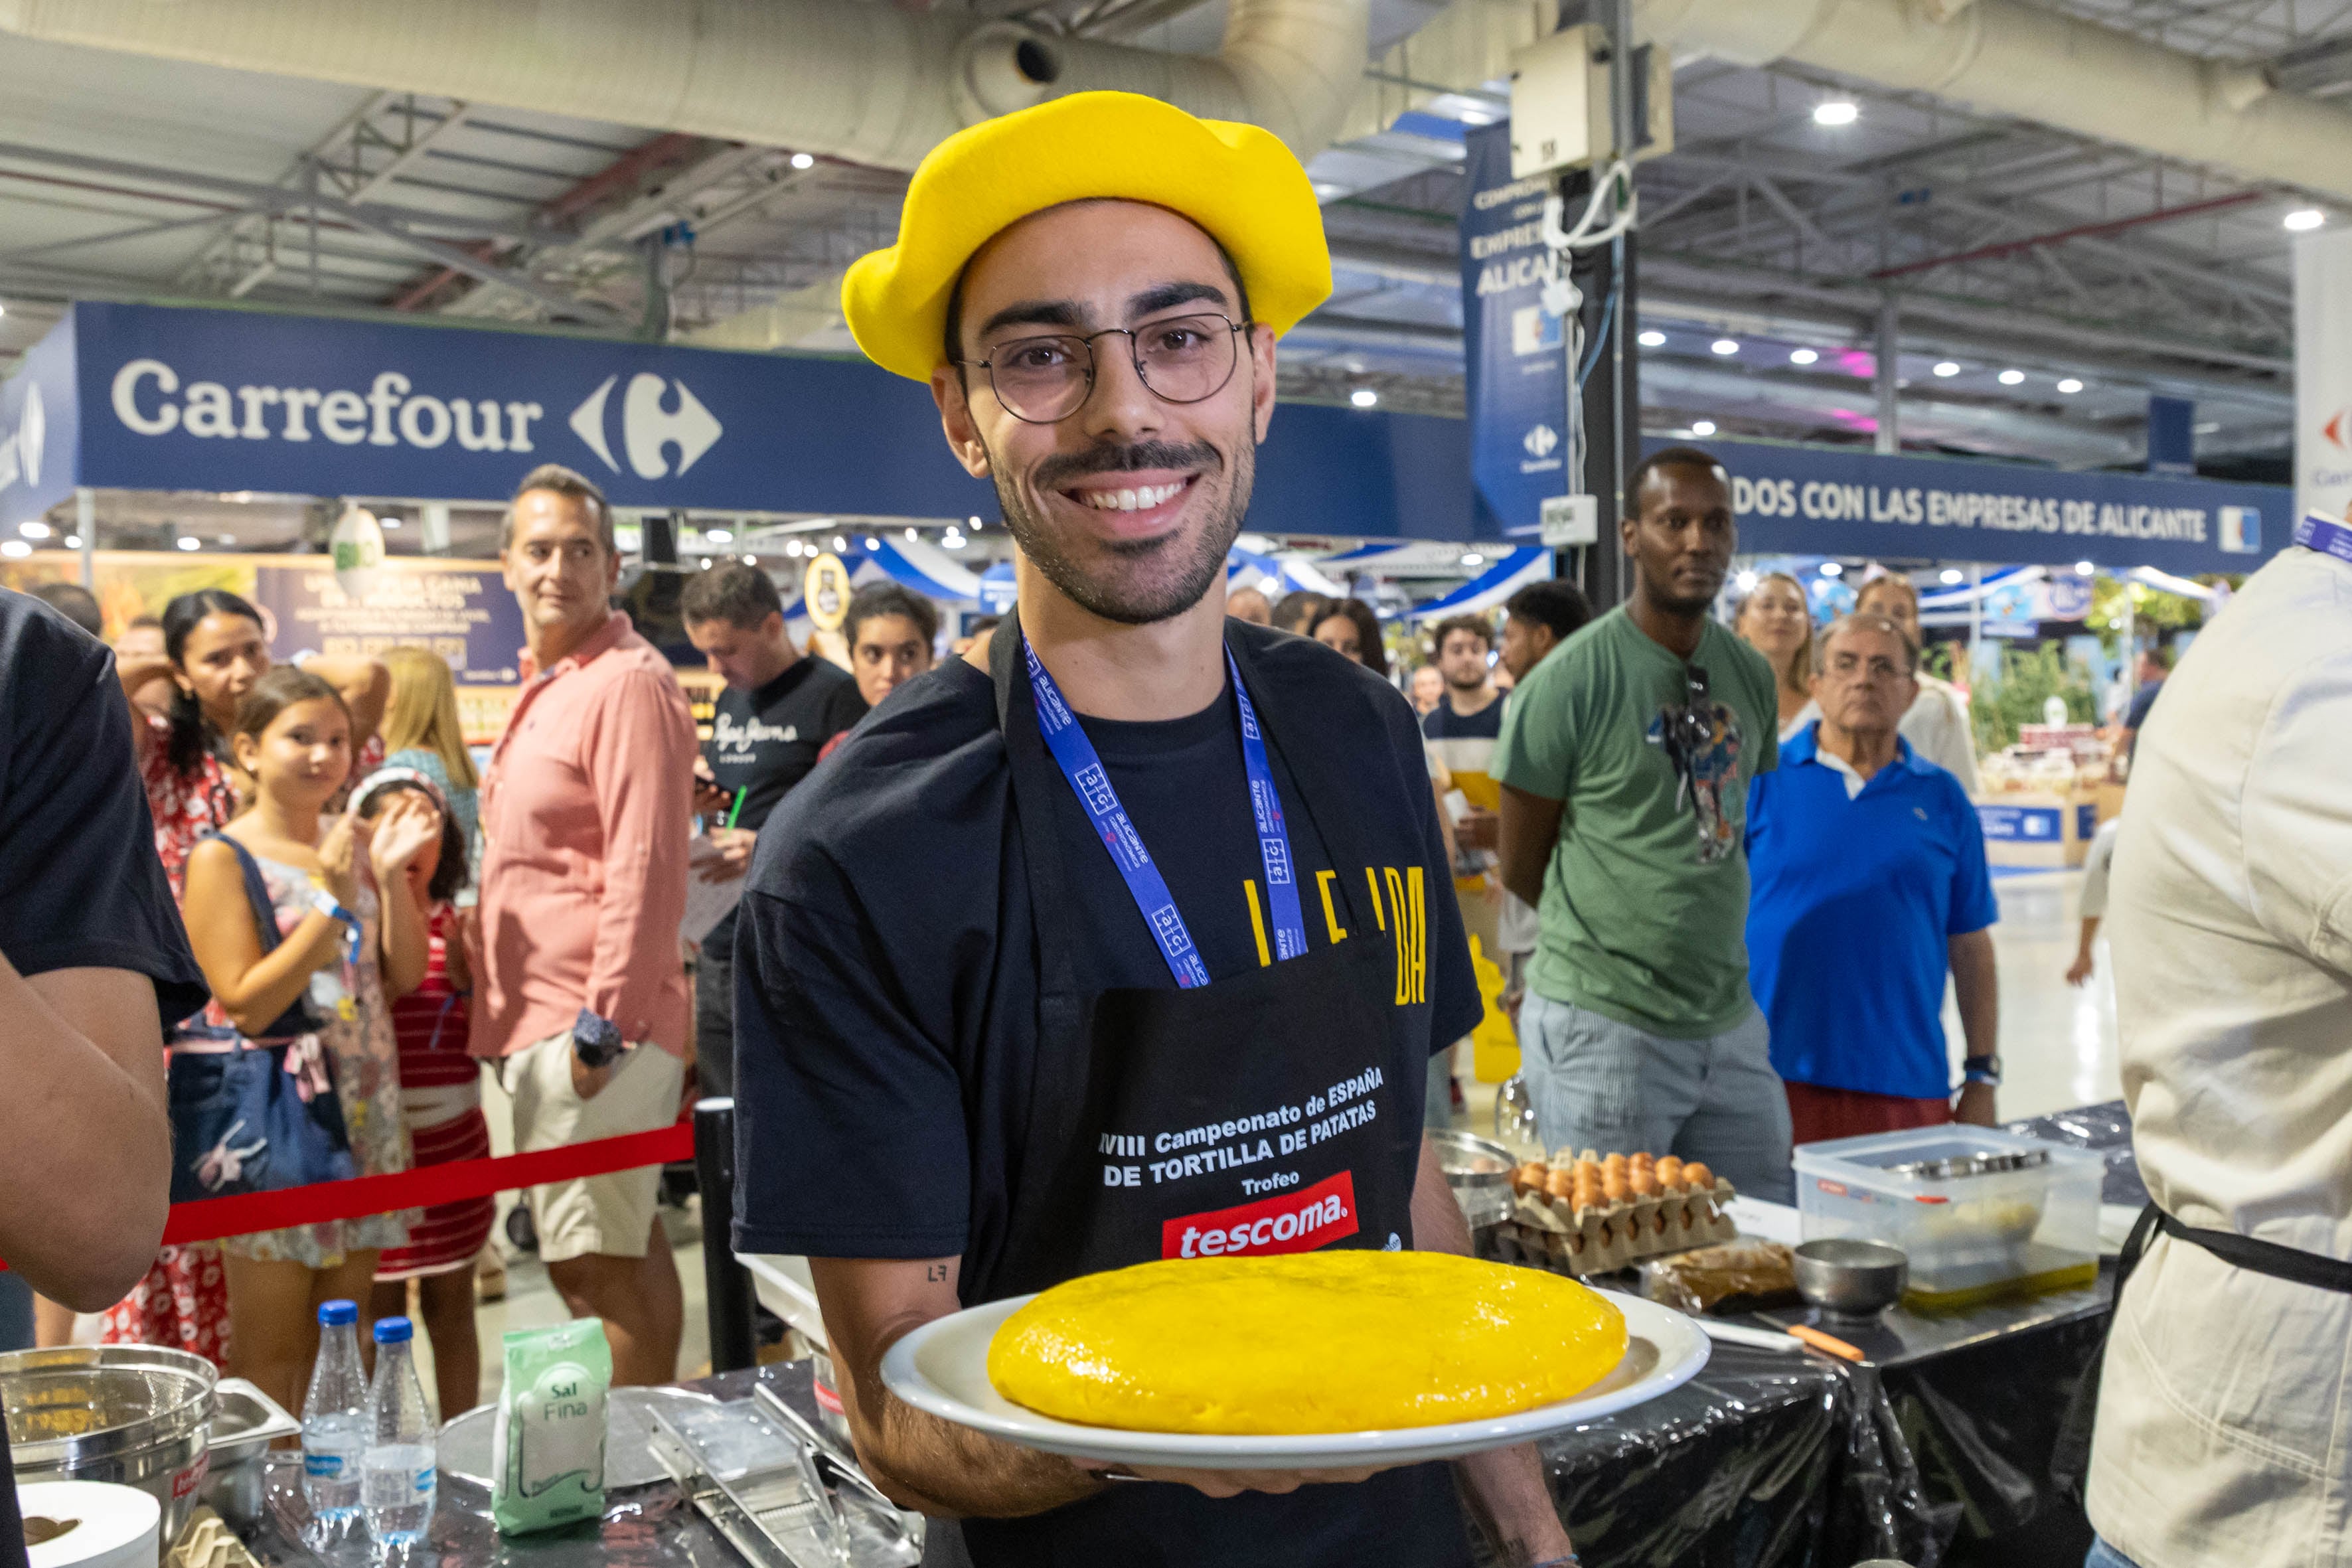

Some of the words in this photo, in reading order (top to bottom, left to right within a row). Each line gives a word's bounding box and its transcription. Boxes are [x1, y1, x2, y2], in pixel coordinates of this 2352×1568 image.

[111, 358, 544, 452] Carrefour
[1801, 480, 1865, 521] CON
[1869, 486, 1924, 525] LAS
[1926, 489, 2059, 533] EMPRESAS
[2061, 499, 2098, 535] DE
[2097, 503, 2208, 543] ALICANTE
[1154, 1105, 1301, 1154] Campeonato
[1305, 1094, 1326, 1118] de
[1328, 1066, 1385, 1109] ESPAÑA
[1103, 1165, 1141, 1188] DE
[1148, 1139, 1275, 1184] TORTILLA
[1279, 1129, 1308, 1156] DE
[1310, 1099, 1377, 1145] PATATAS
[1241, 1170, 1300, 1196] Trofeo
[1180, 1194, 1342, 1259] tescoma
[544, 1402, 588, 1421] Fina
[551, 1382, 577, 1399] Sal
